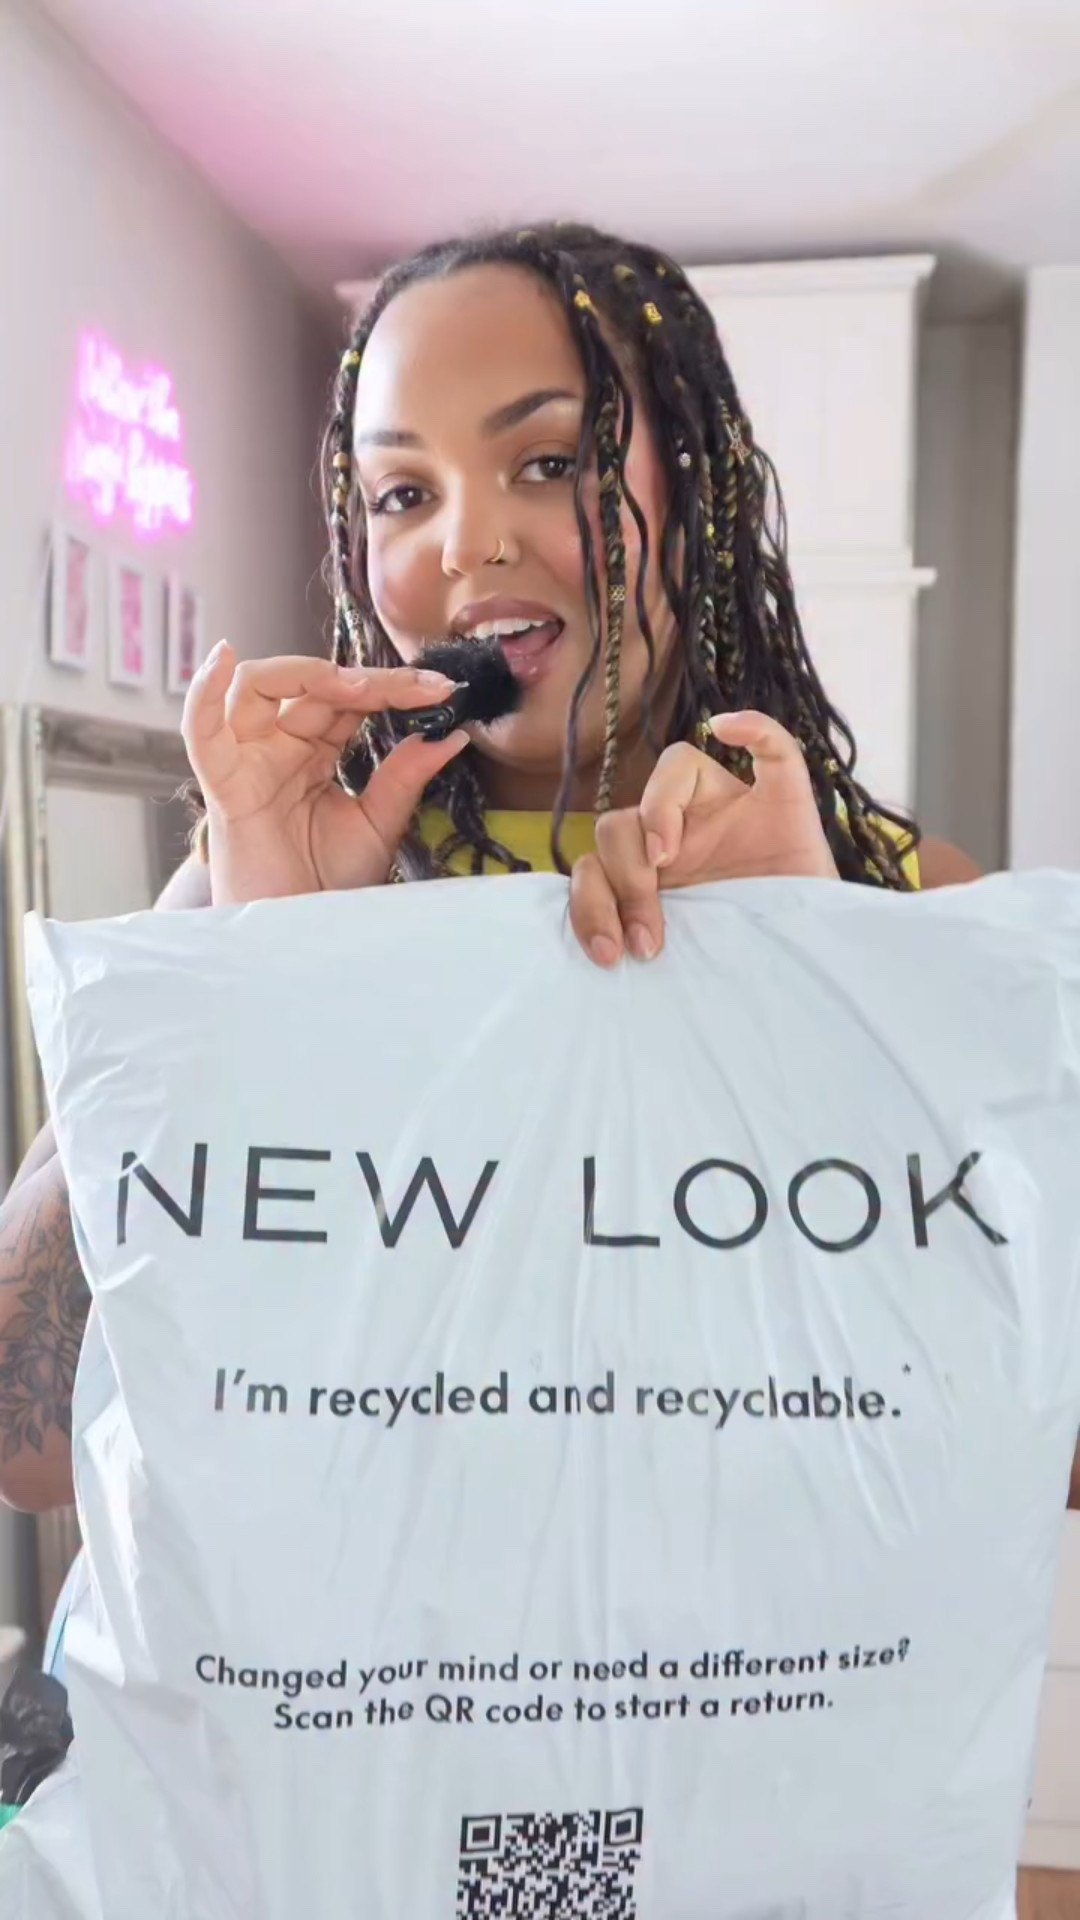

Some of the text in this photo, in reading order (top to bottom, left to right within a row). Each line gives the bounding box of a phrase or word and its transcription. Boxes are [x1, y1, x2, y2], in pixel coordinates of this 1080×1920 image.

[116, 1142, 1009, 1254] NEW LOOK
[309, 1369, 509, 1429] recycled
[527, 1369, 615, 1416] and
[195, 1636, 912, 1699] Changed your mind or need a different size?
[273, 1689, 834, 1732] Scan the QR code to start a return.
